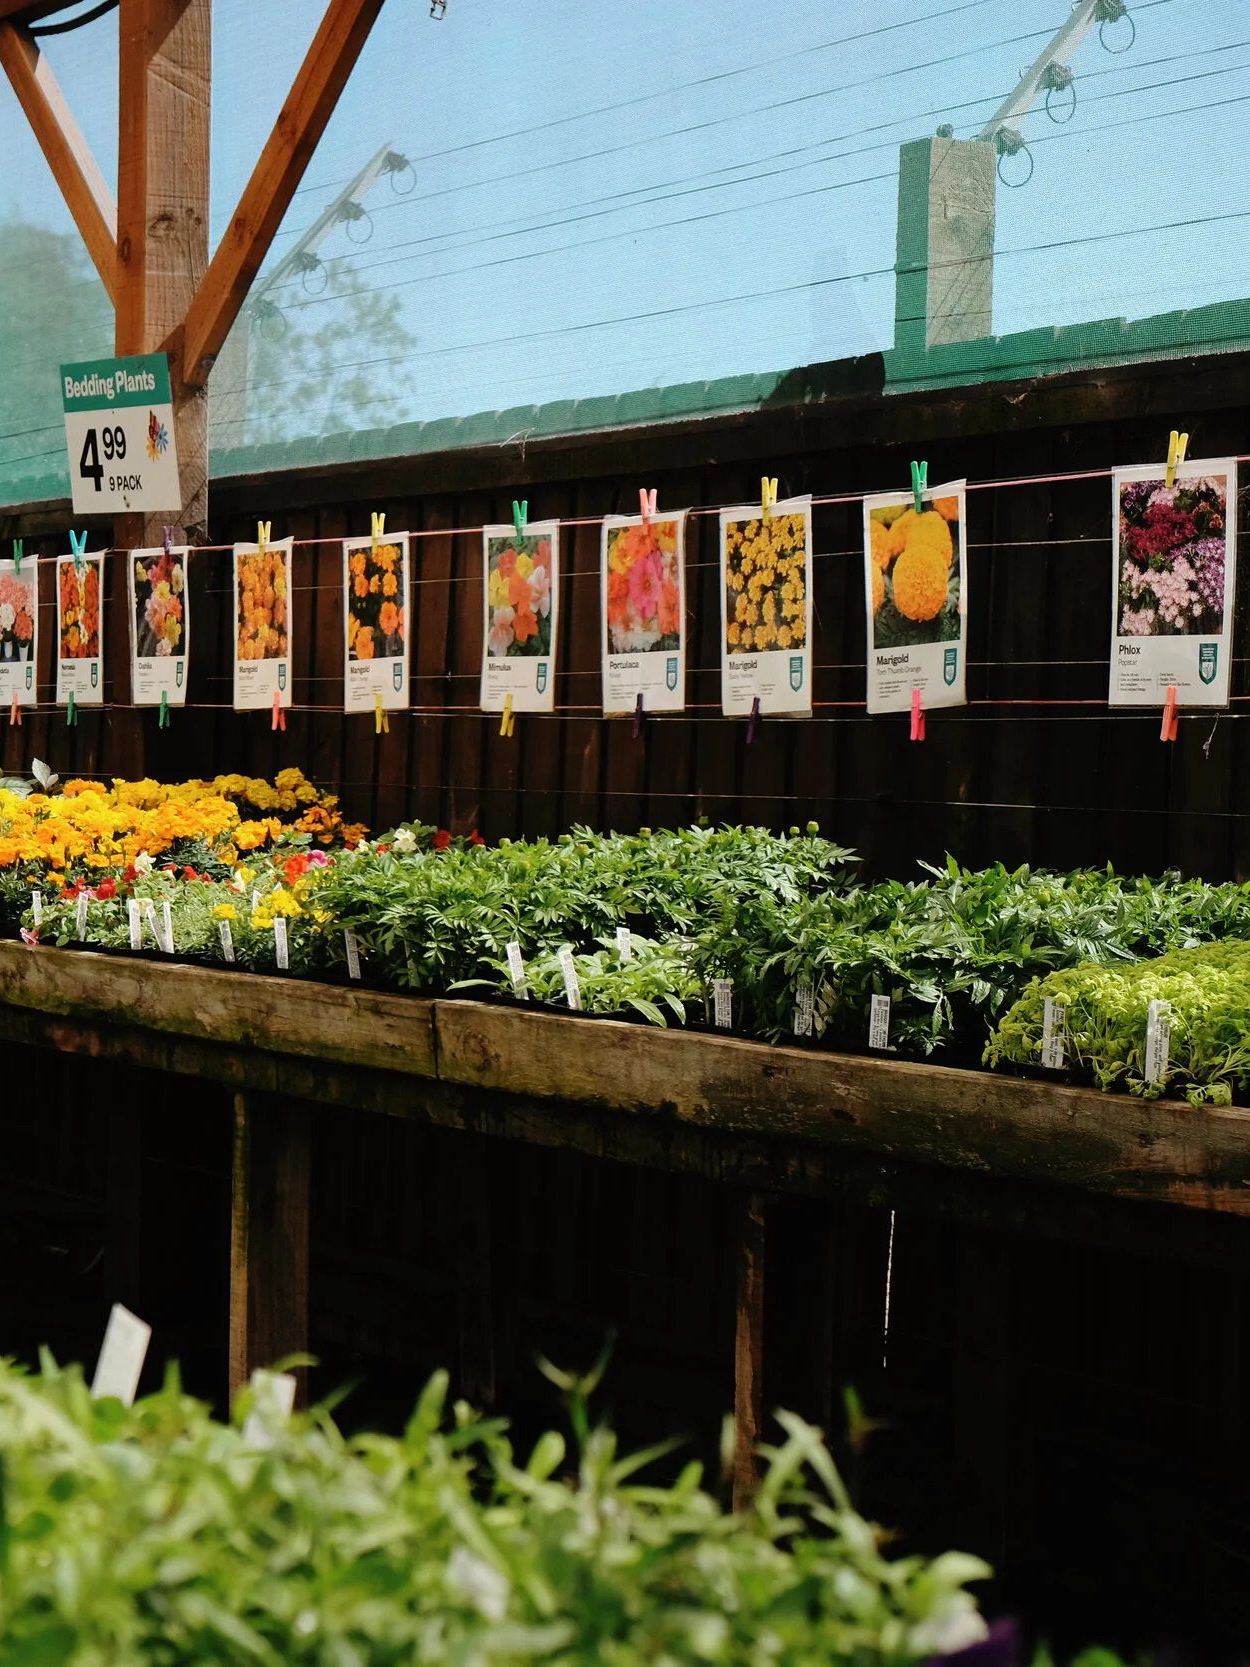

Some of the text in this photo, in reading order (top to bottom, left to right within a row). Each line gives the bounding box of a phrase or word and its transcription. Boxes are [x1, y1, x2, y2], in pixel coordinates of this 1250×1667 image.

[64, 370, 156, 400] Bedding Plants
[109, 474, 143, 492] 9 PACK
[1118, 644, 1141, 655] Phlox
[609, 660, 639, 670] Portulaca
[729, 660, 758, 671] Marigold
[876, 653, 909, 666] Marigold
